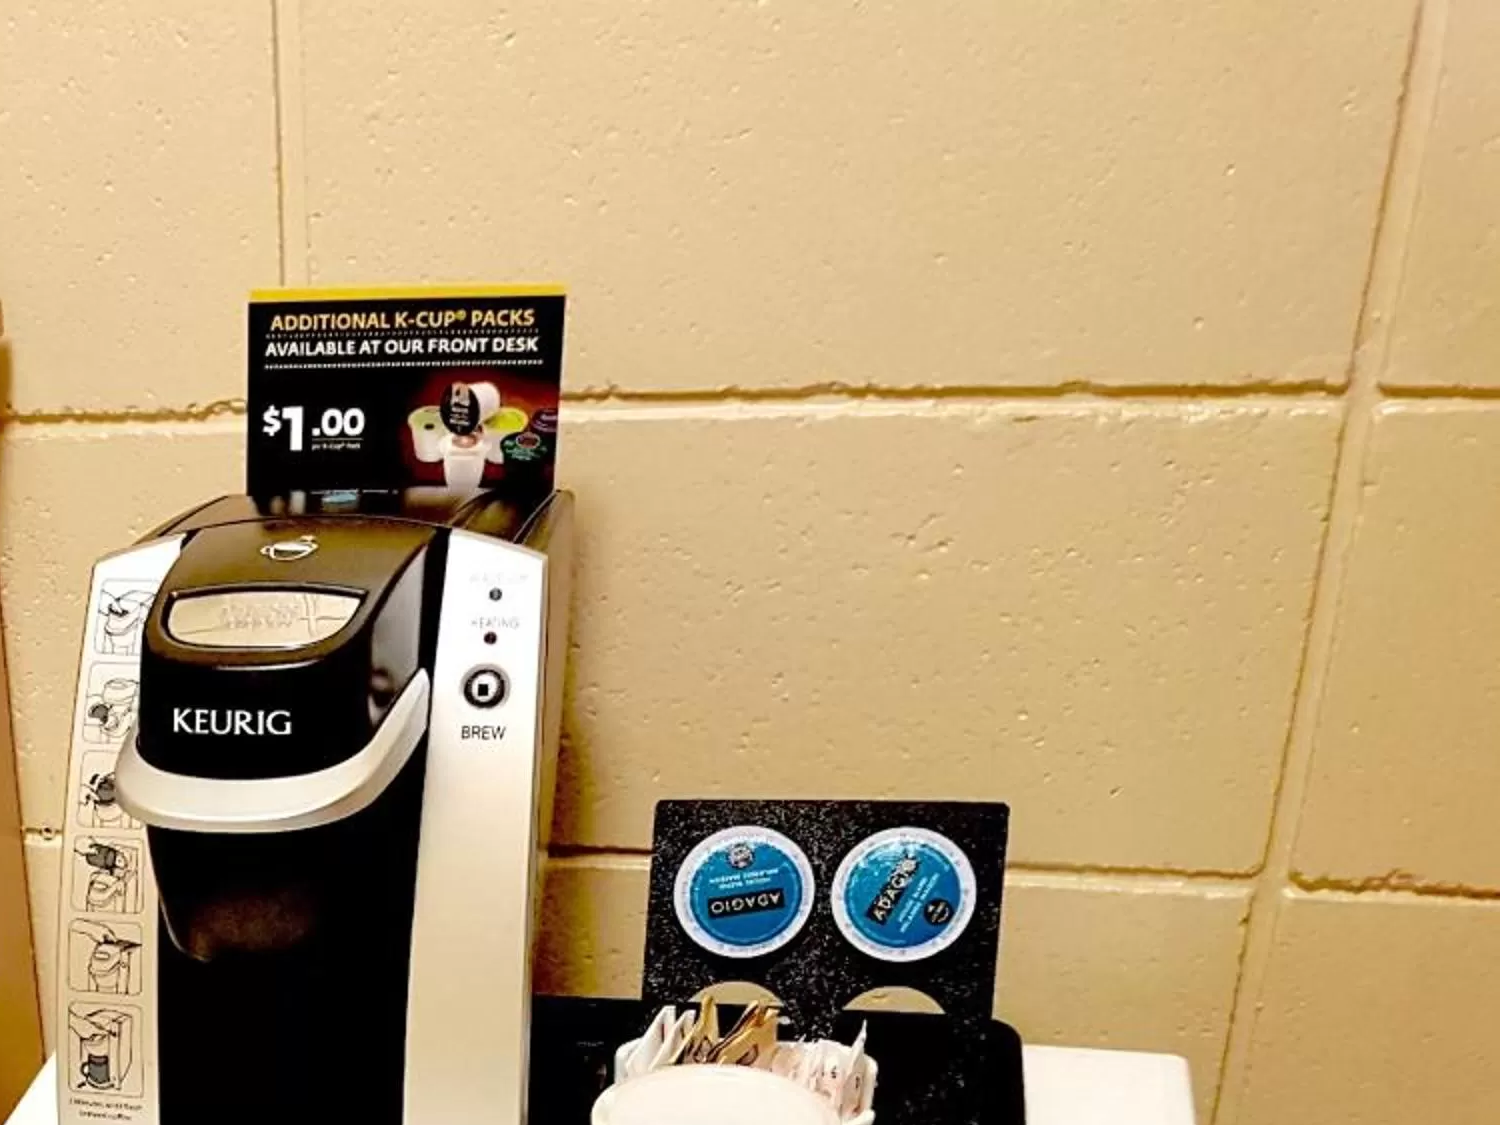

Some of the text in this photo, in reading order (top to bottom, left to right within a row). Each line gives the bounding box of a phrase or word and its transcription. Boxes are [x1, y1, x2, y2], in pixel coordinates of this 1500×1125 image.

[270, 312, 391, 333] ADDITIONAL
[471, 308, 536, 327] PACKS
[264, 336, 540, 358] AVAILABLE AT OUR FRONT DESK
[172, 707, 293, 737] KEURIG
[460, 725, 506, 741] BREW
[709, 890, 781, 915] ADAGIO
